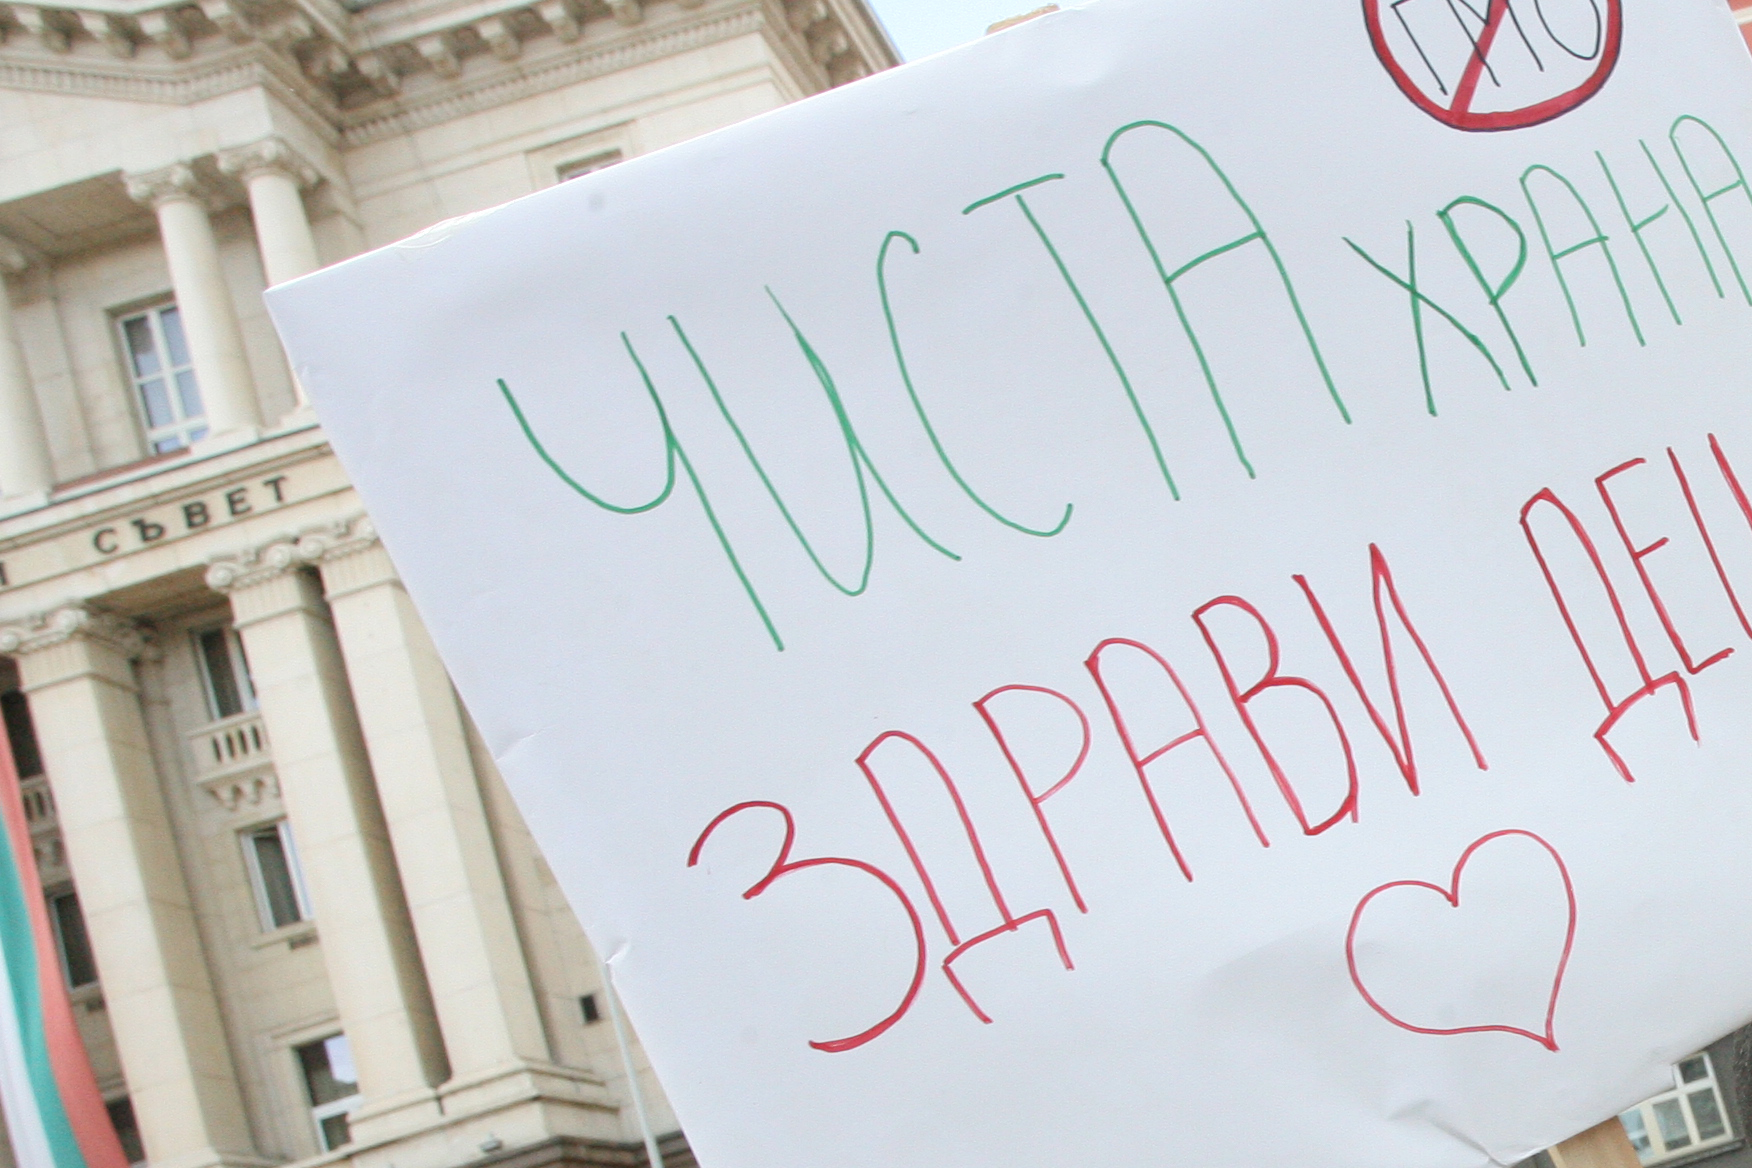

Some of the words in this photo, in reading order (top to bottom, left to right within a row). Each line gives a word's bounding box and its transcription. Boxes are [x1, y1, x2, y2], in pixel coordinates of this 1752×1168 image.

[92, 474, 287, 555] СЪВЕТ
[496, 119, 1351, 651] ЧИСТА
[687, 543, 1488, 1053] ЗДРАВИ
